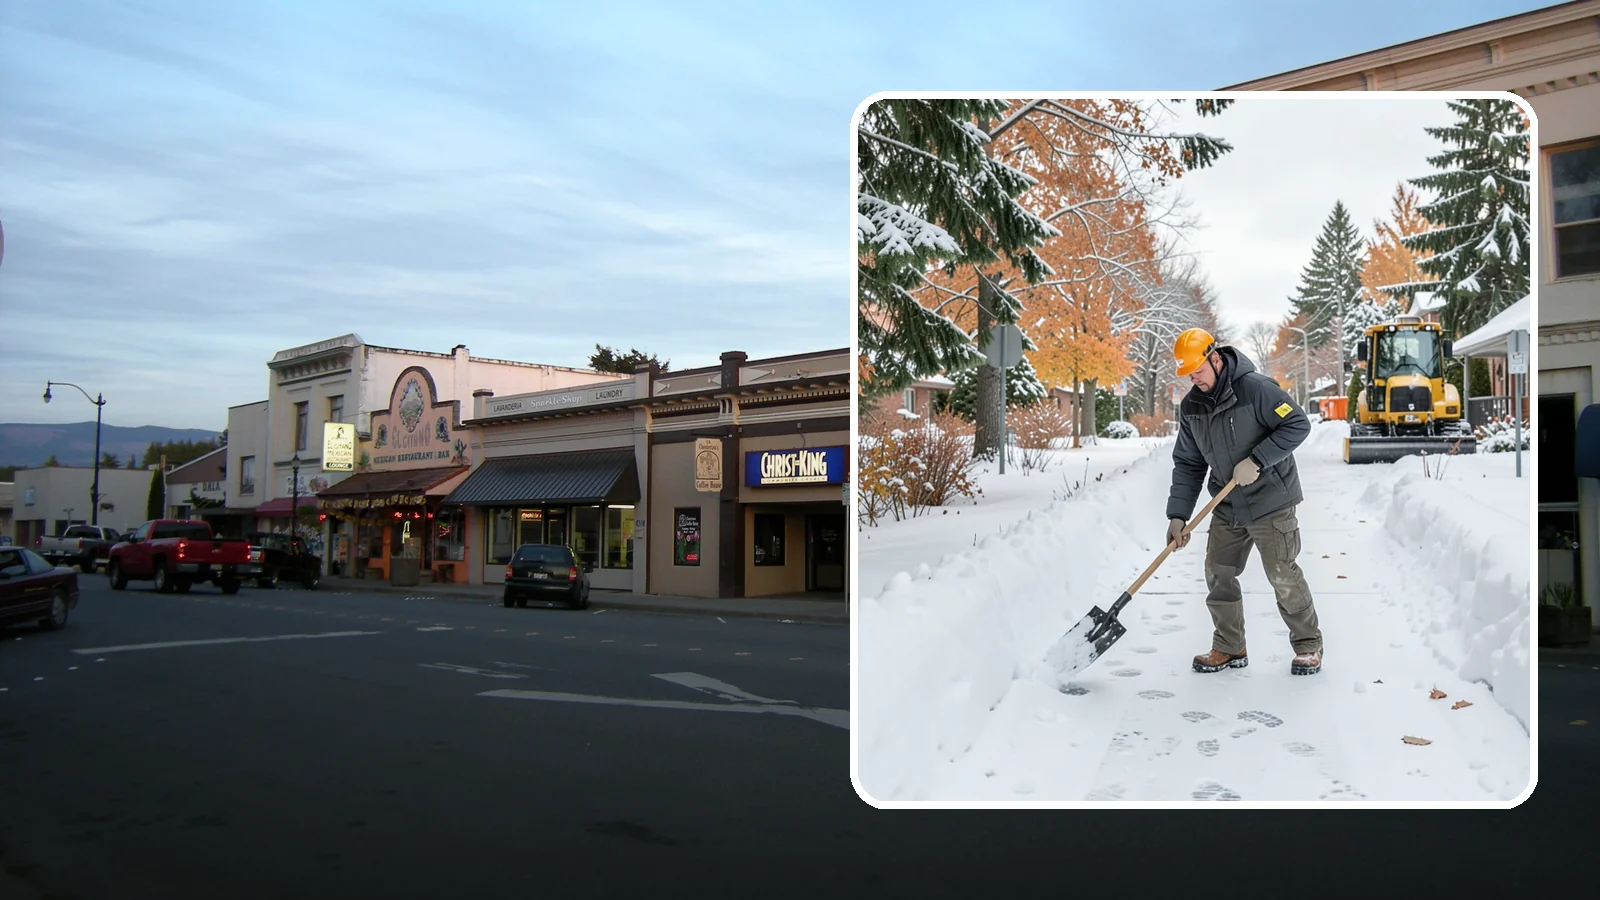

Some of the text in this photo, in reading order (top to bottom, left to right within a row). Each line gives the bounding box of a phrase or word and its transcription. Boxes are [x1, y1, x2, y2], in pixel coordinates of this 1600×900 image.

[562, 394, 582, 405] Shop
[595, 388, 623, 400] LAUNDRY
[493, 402, 522, 413] LAVANDERIA
[392, 425, 402, 449] EL
[397, 451, 433, 463] RESTAURANT
[437, 450, 450, 459] BAR
[696, 480, 721, 489] Coffee House
